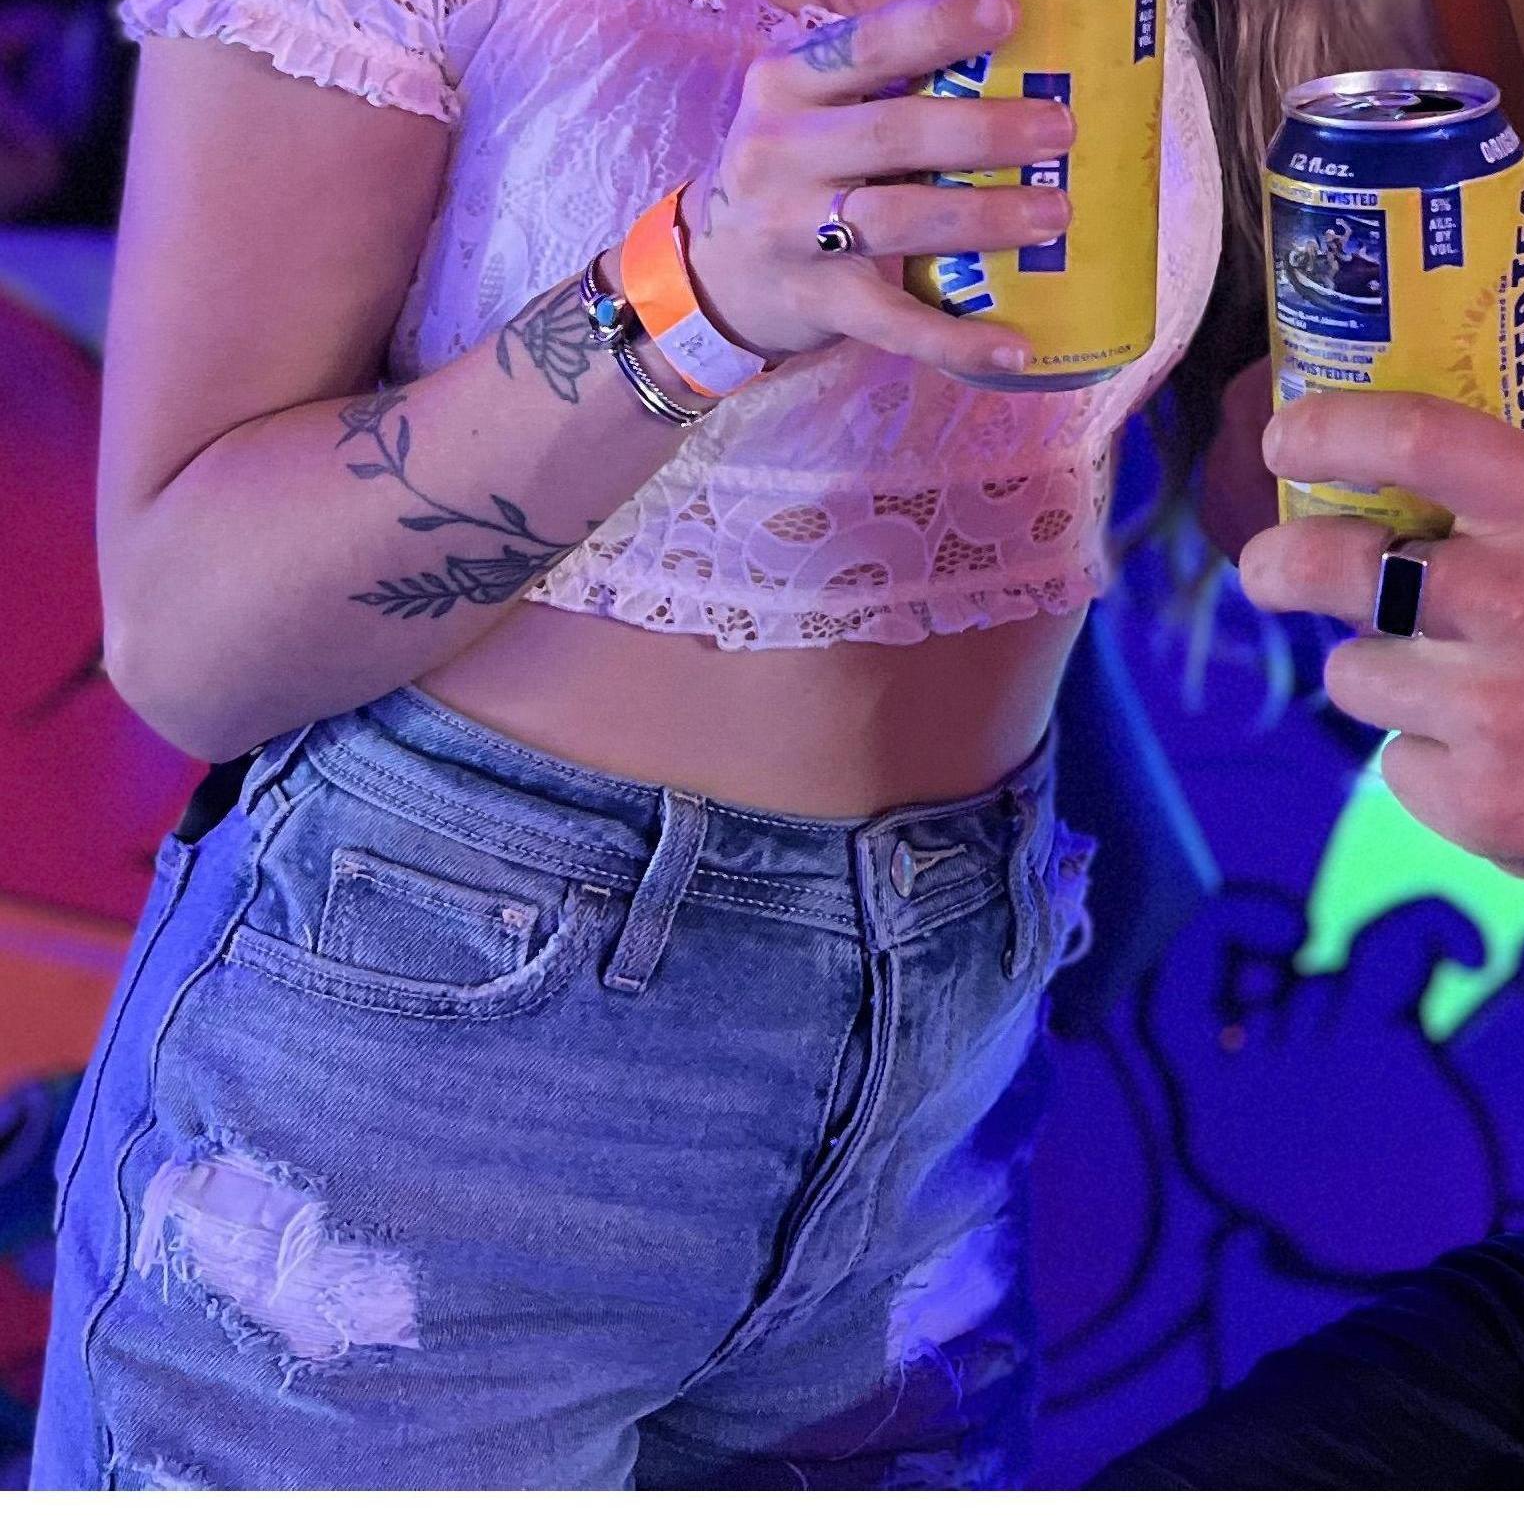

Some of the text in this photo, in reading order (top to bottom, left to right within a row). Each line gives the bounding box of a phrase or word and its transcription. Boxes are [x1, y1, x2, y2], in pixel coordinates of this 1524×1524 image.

[1319, 189, 1378, 206] TWISTED
[1430, 198, 1452, 213] 5%
[1435, 230, 1452, 243] BY
